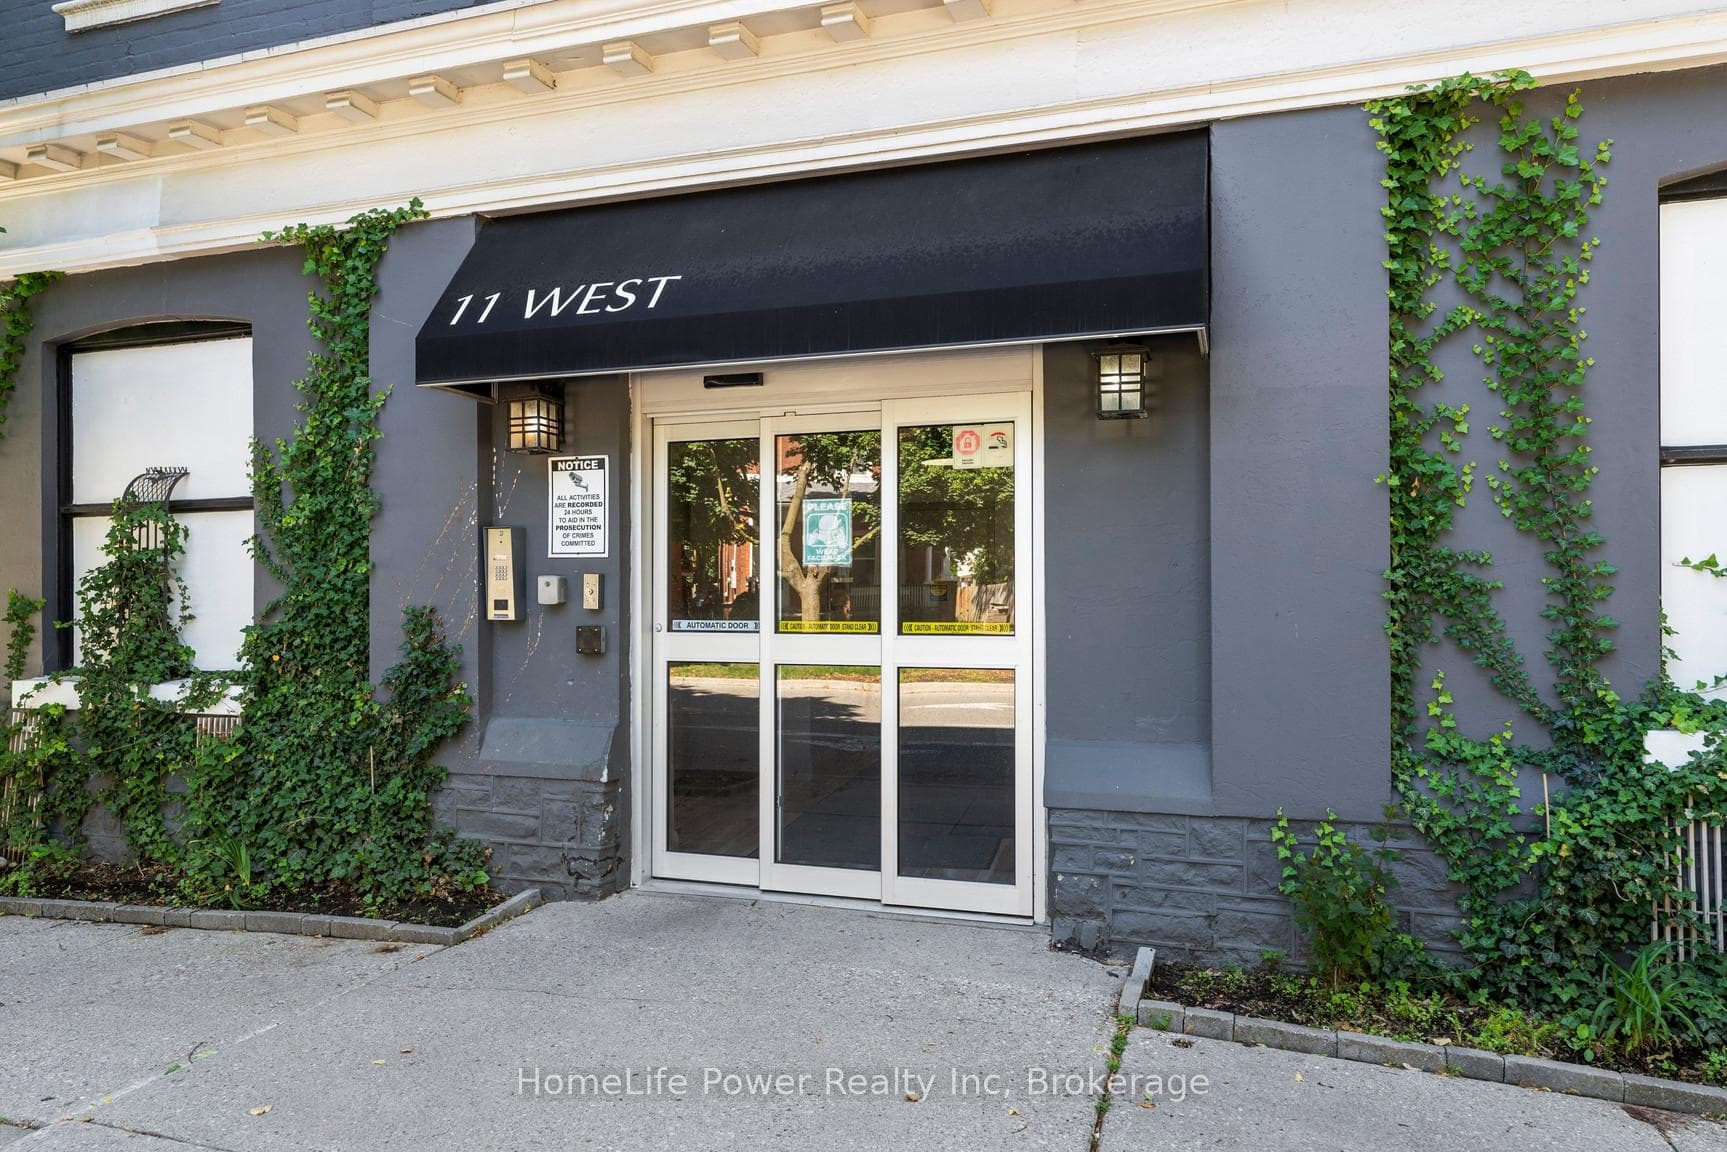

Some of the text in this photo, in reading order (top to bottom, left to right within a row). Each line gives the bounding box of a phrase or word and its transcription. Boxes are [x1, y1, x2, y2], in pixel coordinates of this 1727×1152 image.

[450, 275, 682, 326] 11 WEST
[557, 460, 599, 471] NOTICE
[807, 502, 847, 511] PLEASE
[914, 623, 931, 632] CAUTION
[935, 624, 956, 632] AUTOMATIC
